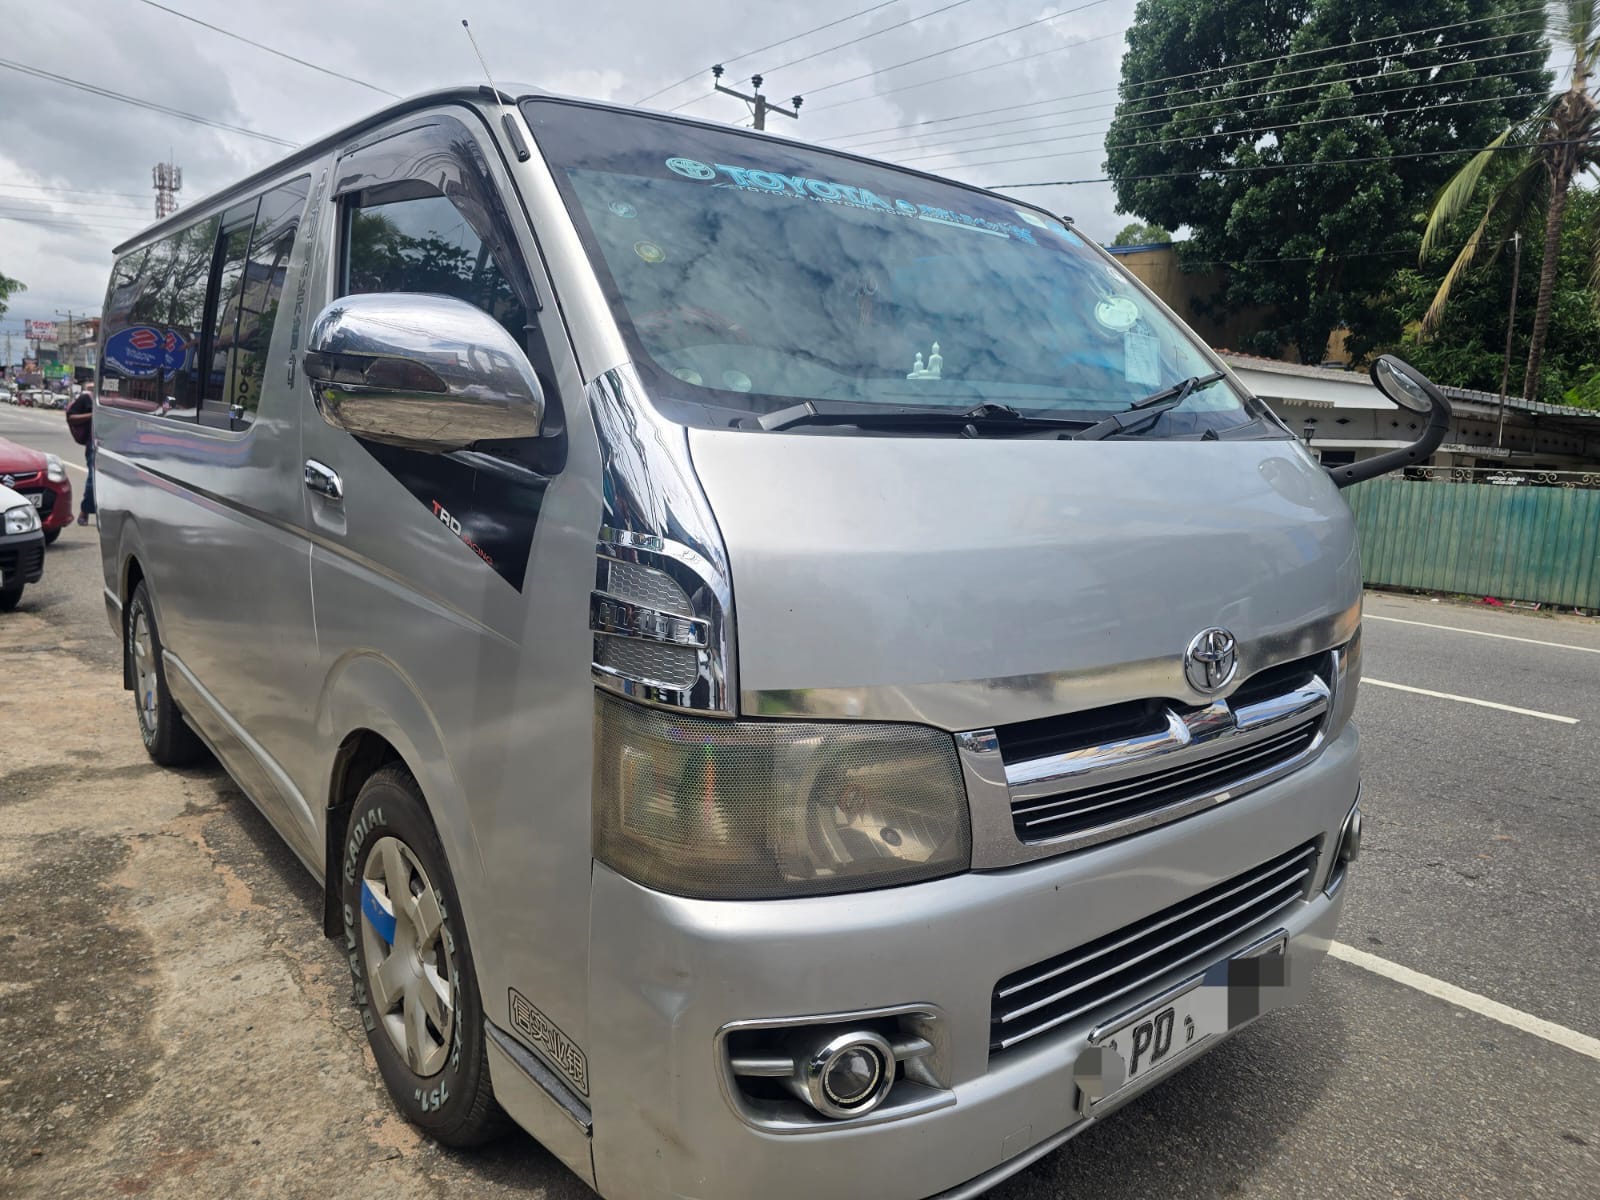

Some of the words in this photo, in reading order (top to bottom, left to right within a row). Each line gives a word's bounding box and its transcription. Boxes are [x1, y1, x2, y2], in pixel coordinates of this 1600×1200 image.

[714, 163, 893, 210] TOYOTA
[432, 499, 462, 536] TRD
[345, 807, 388, 888] RADIAL
[344, 903, 377, 1033] BRAVO
[512, 995, 586, 1089] 信实业银
[1129, 1007, 1175, 1078] PD
